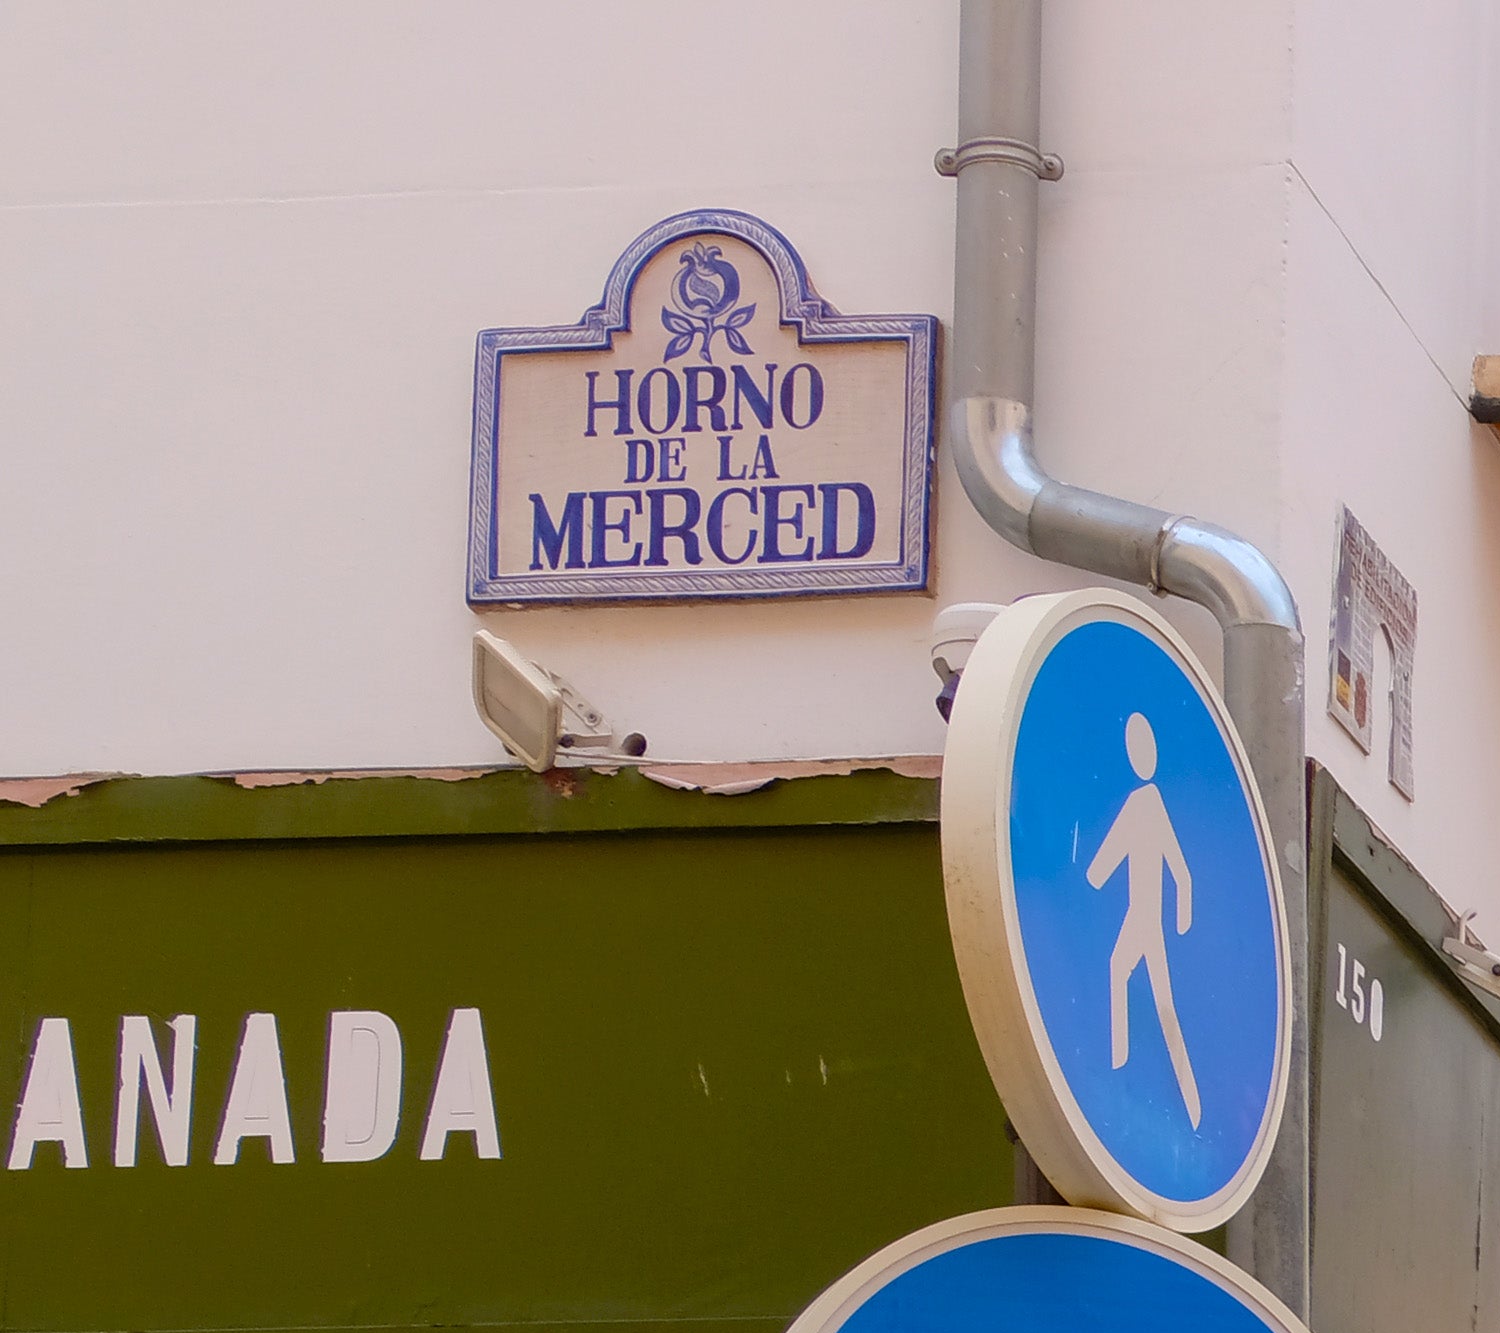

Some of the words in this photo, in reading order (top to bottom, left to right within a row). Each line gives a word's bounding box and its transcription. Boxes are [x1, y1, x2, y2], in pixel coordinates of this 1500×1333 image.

[585, 363, 824, 436] HORNO
[623, 437, 687, 484] DE
[717, 434, 779, 482] LA
[528, 482, 876, 572] MERCED
[1335, 942, 1383, 1042] 150
[7, 1007, 501, 1170] ANADA
